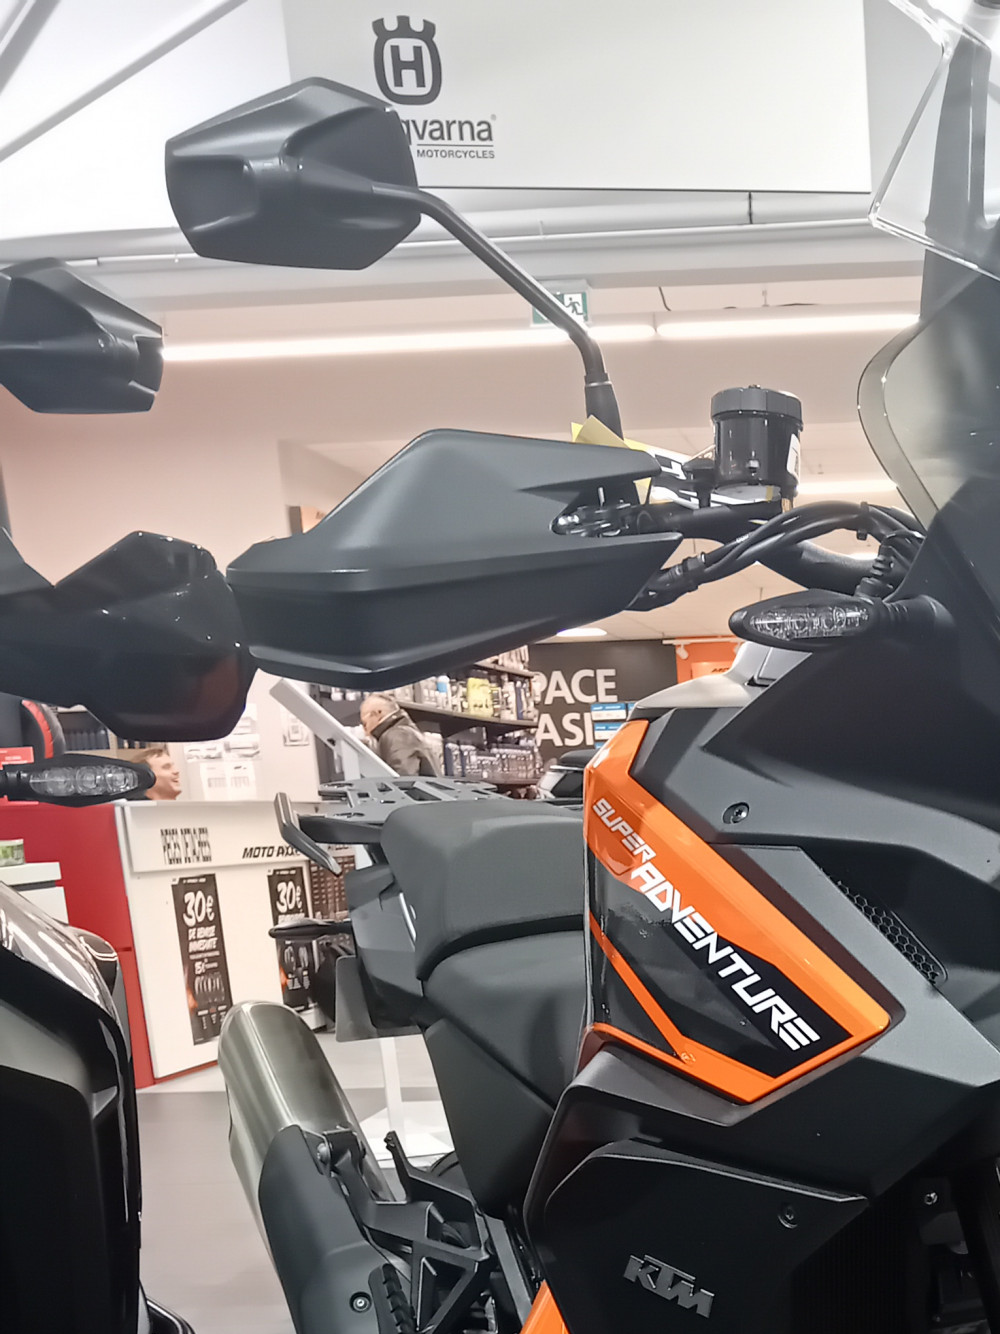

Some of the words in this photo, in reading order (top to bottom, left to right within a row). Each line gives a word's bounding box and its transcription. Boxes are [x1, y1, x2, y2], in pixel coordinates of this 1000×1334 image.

[417, 149, 495, 159] MOTORCYCLES
[592, 798, 657, 863] SUPER
[242, 845, 275, 859] MOTO
[183, 890, 215, 927] 30€
[276, 881, 303, 913] 30€
[630, 862, 821, 1051] ADVENTURE
[623, 1254, 715, 1319] KTM
